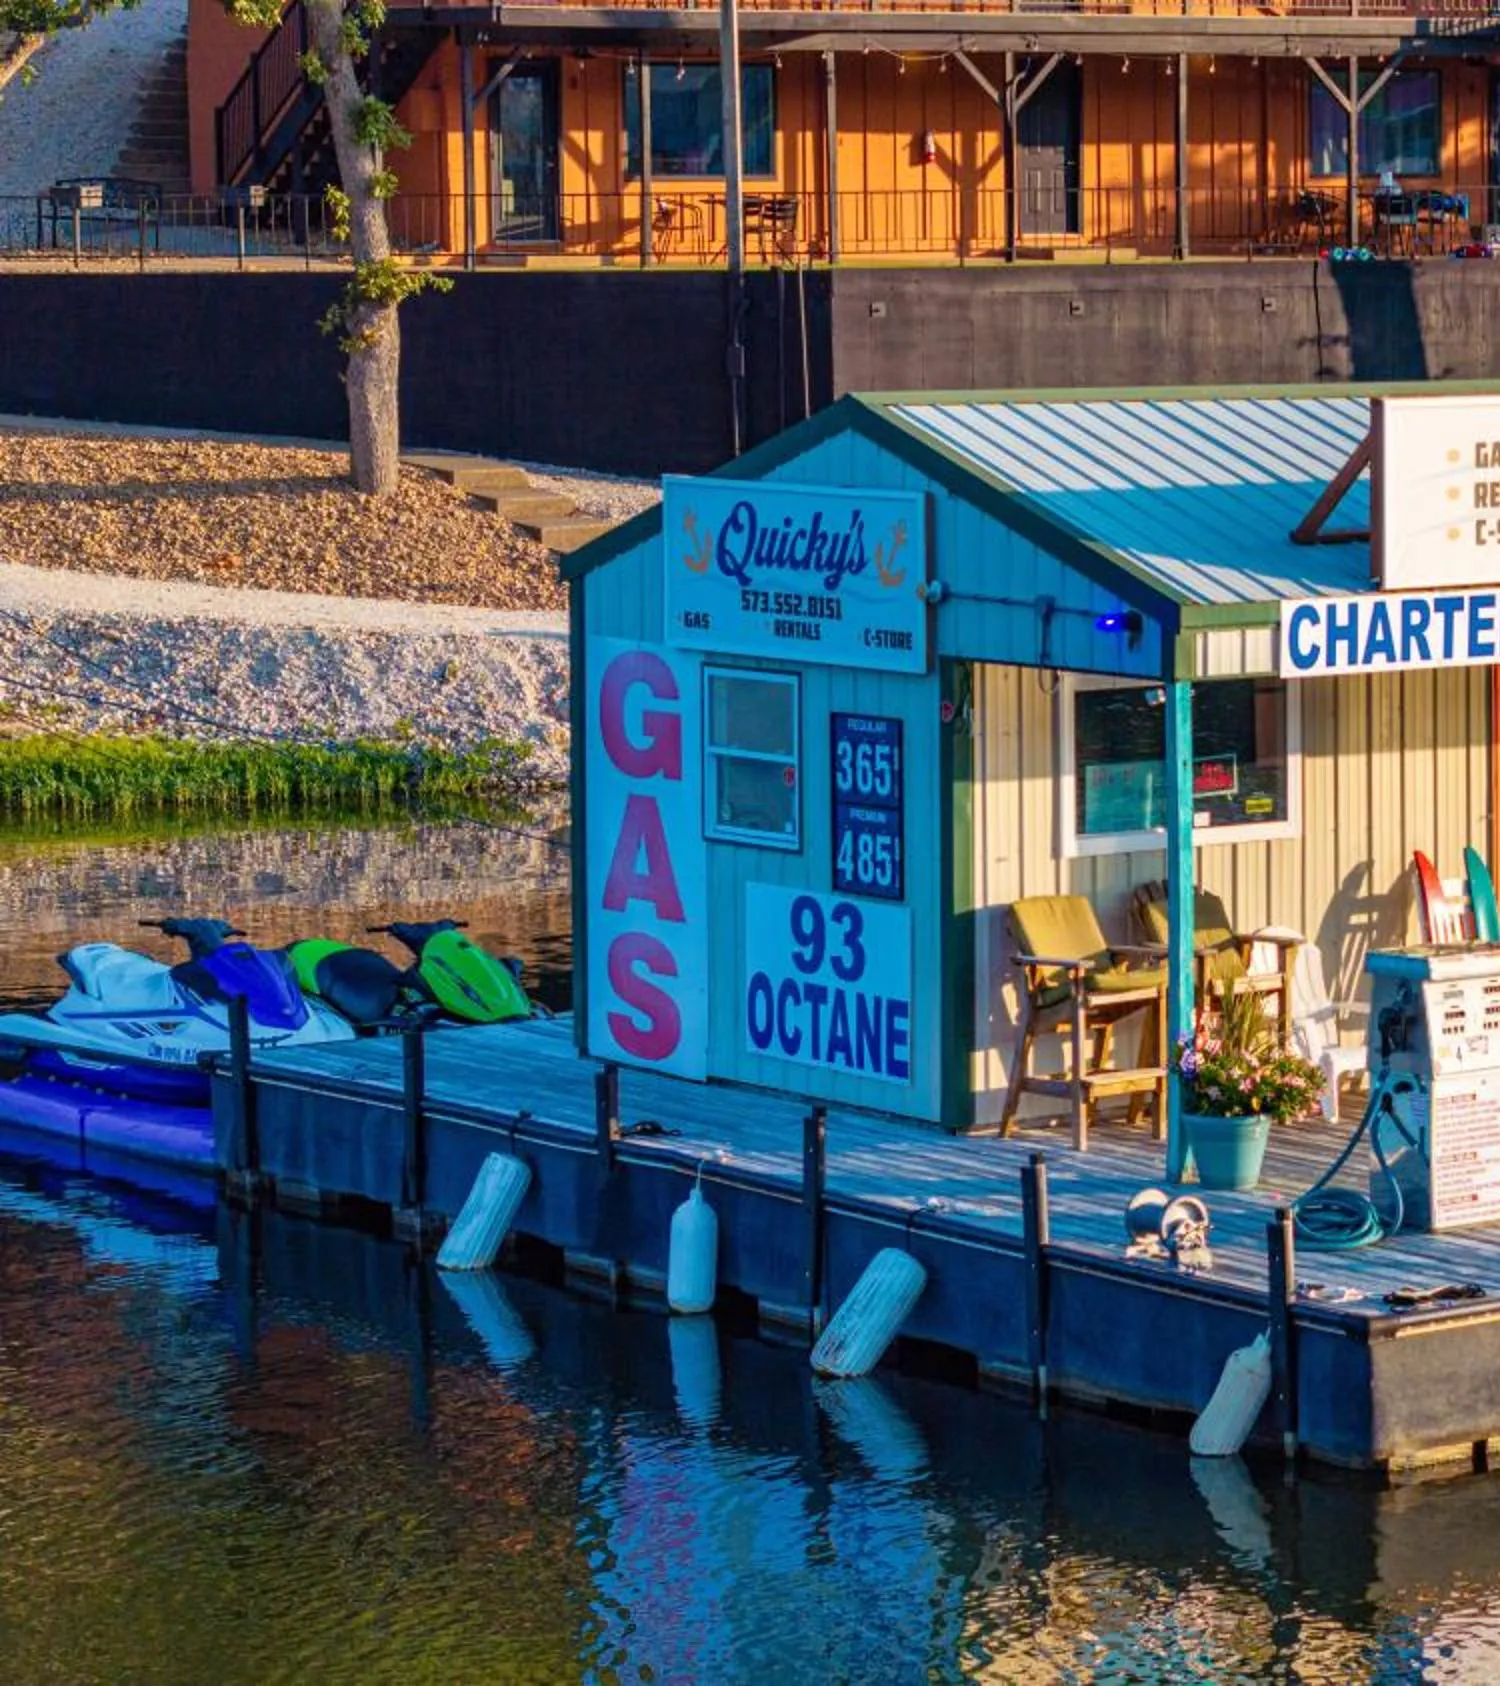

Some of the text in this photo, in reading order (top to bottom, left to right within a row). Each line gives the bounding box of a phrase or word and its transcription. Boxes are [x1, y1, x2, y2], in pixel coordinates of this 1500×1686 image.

[716, 500, 868, 590] Quicky's
[683, 610, 710, 630] GAS
[740, 588, 843, 621] 573.552.8151
[773, 618, 822, 641] RENTALS
[862, 627, 914, 651] C-STORE
[836, 738, 892, 797] 365
[600, 650, 687, 1061] GAS
[836, 829, 893, 886] 485
[790, 894, 866, 983] 93
[746, 970, 909, 1080] OCTANE
